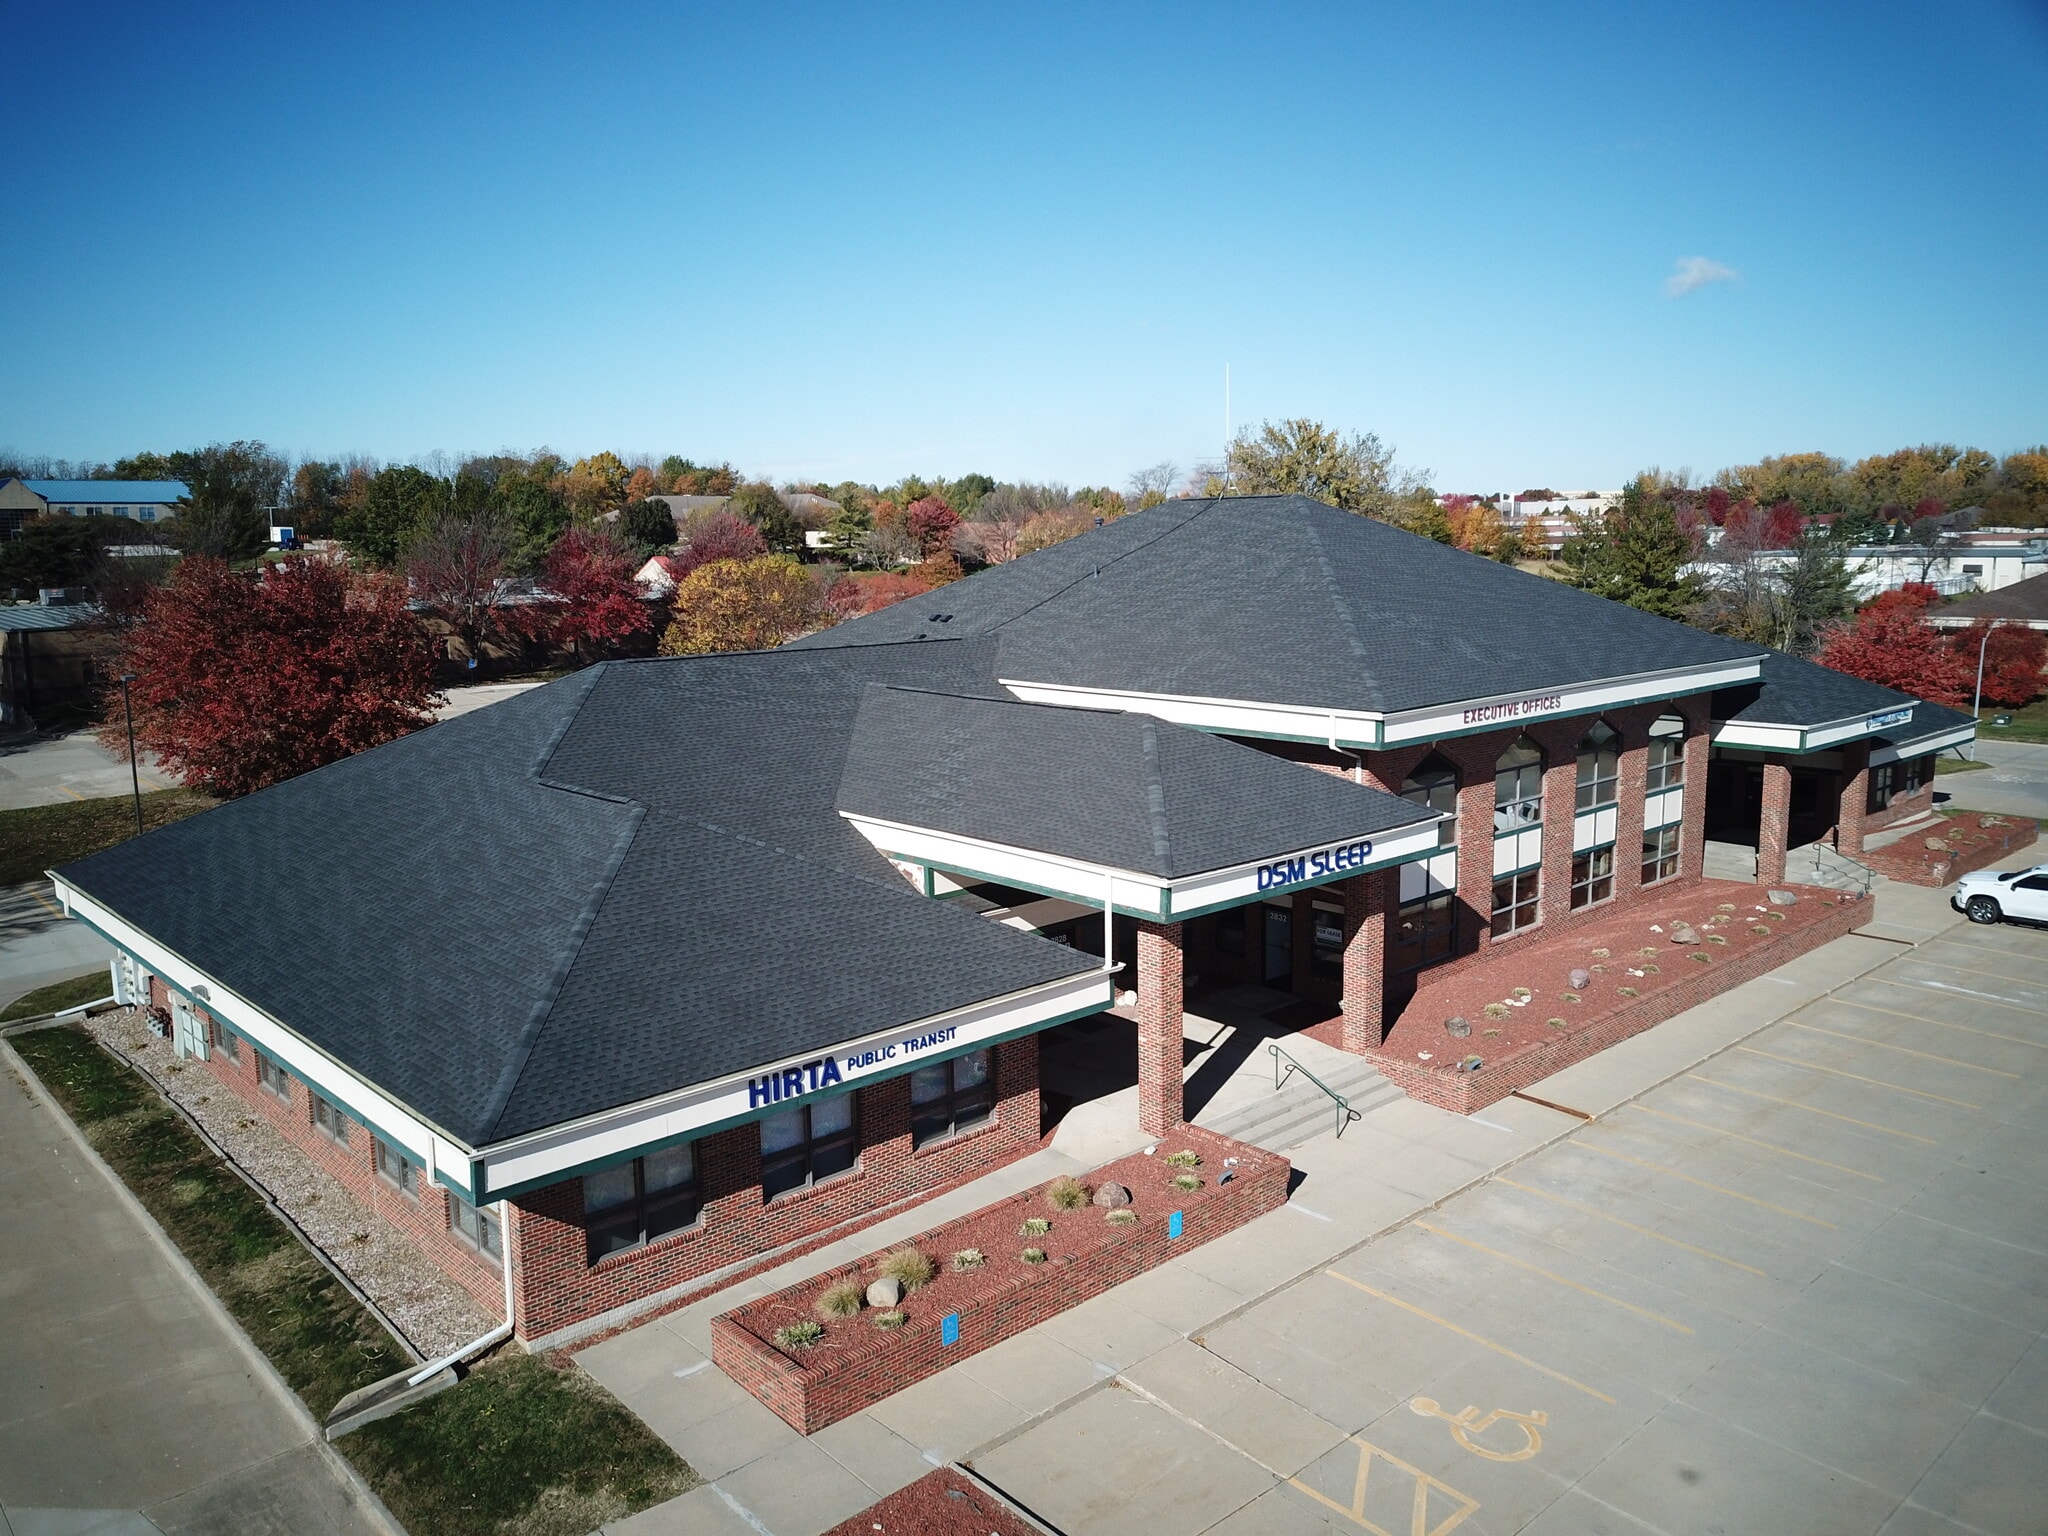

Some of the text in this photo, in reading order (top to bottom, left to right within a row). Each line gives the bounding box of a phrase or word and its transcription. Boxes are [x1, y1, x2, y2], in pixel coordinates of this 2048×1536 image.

[1463, 695, 1561, 724] EXECUTIVE OFFICES
[1257, 840, 1373, 891] DSM SLEEP
[1270, 912, 1287, 923] 2832
[1326, 929, 1341, 938] LEASE
[748, 1026, 957, 1108] HIRTA PUBLIC TRANSIT
